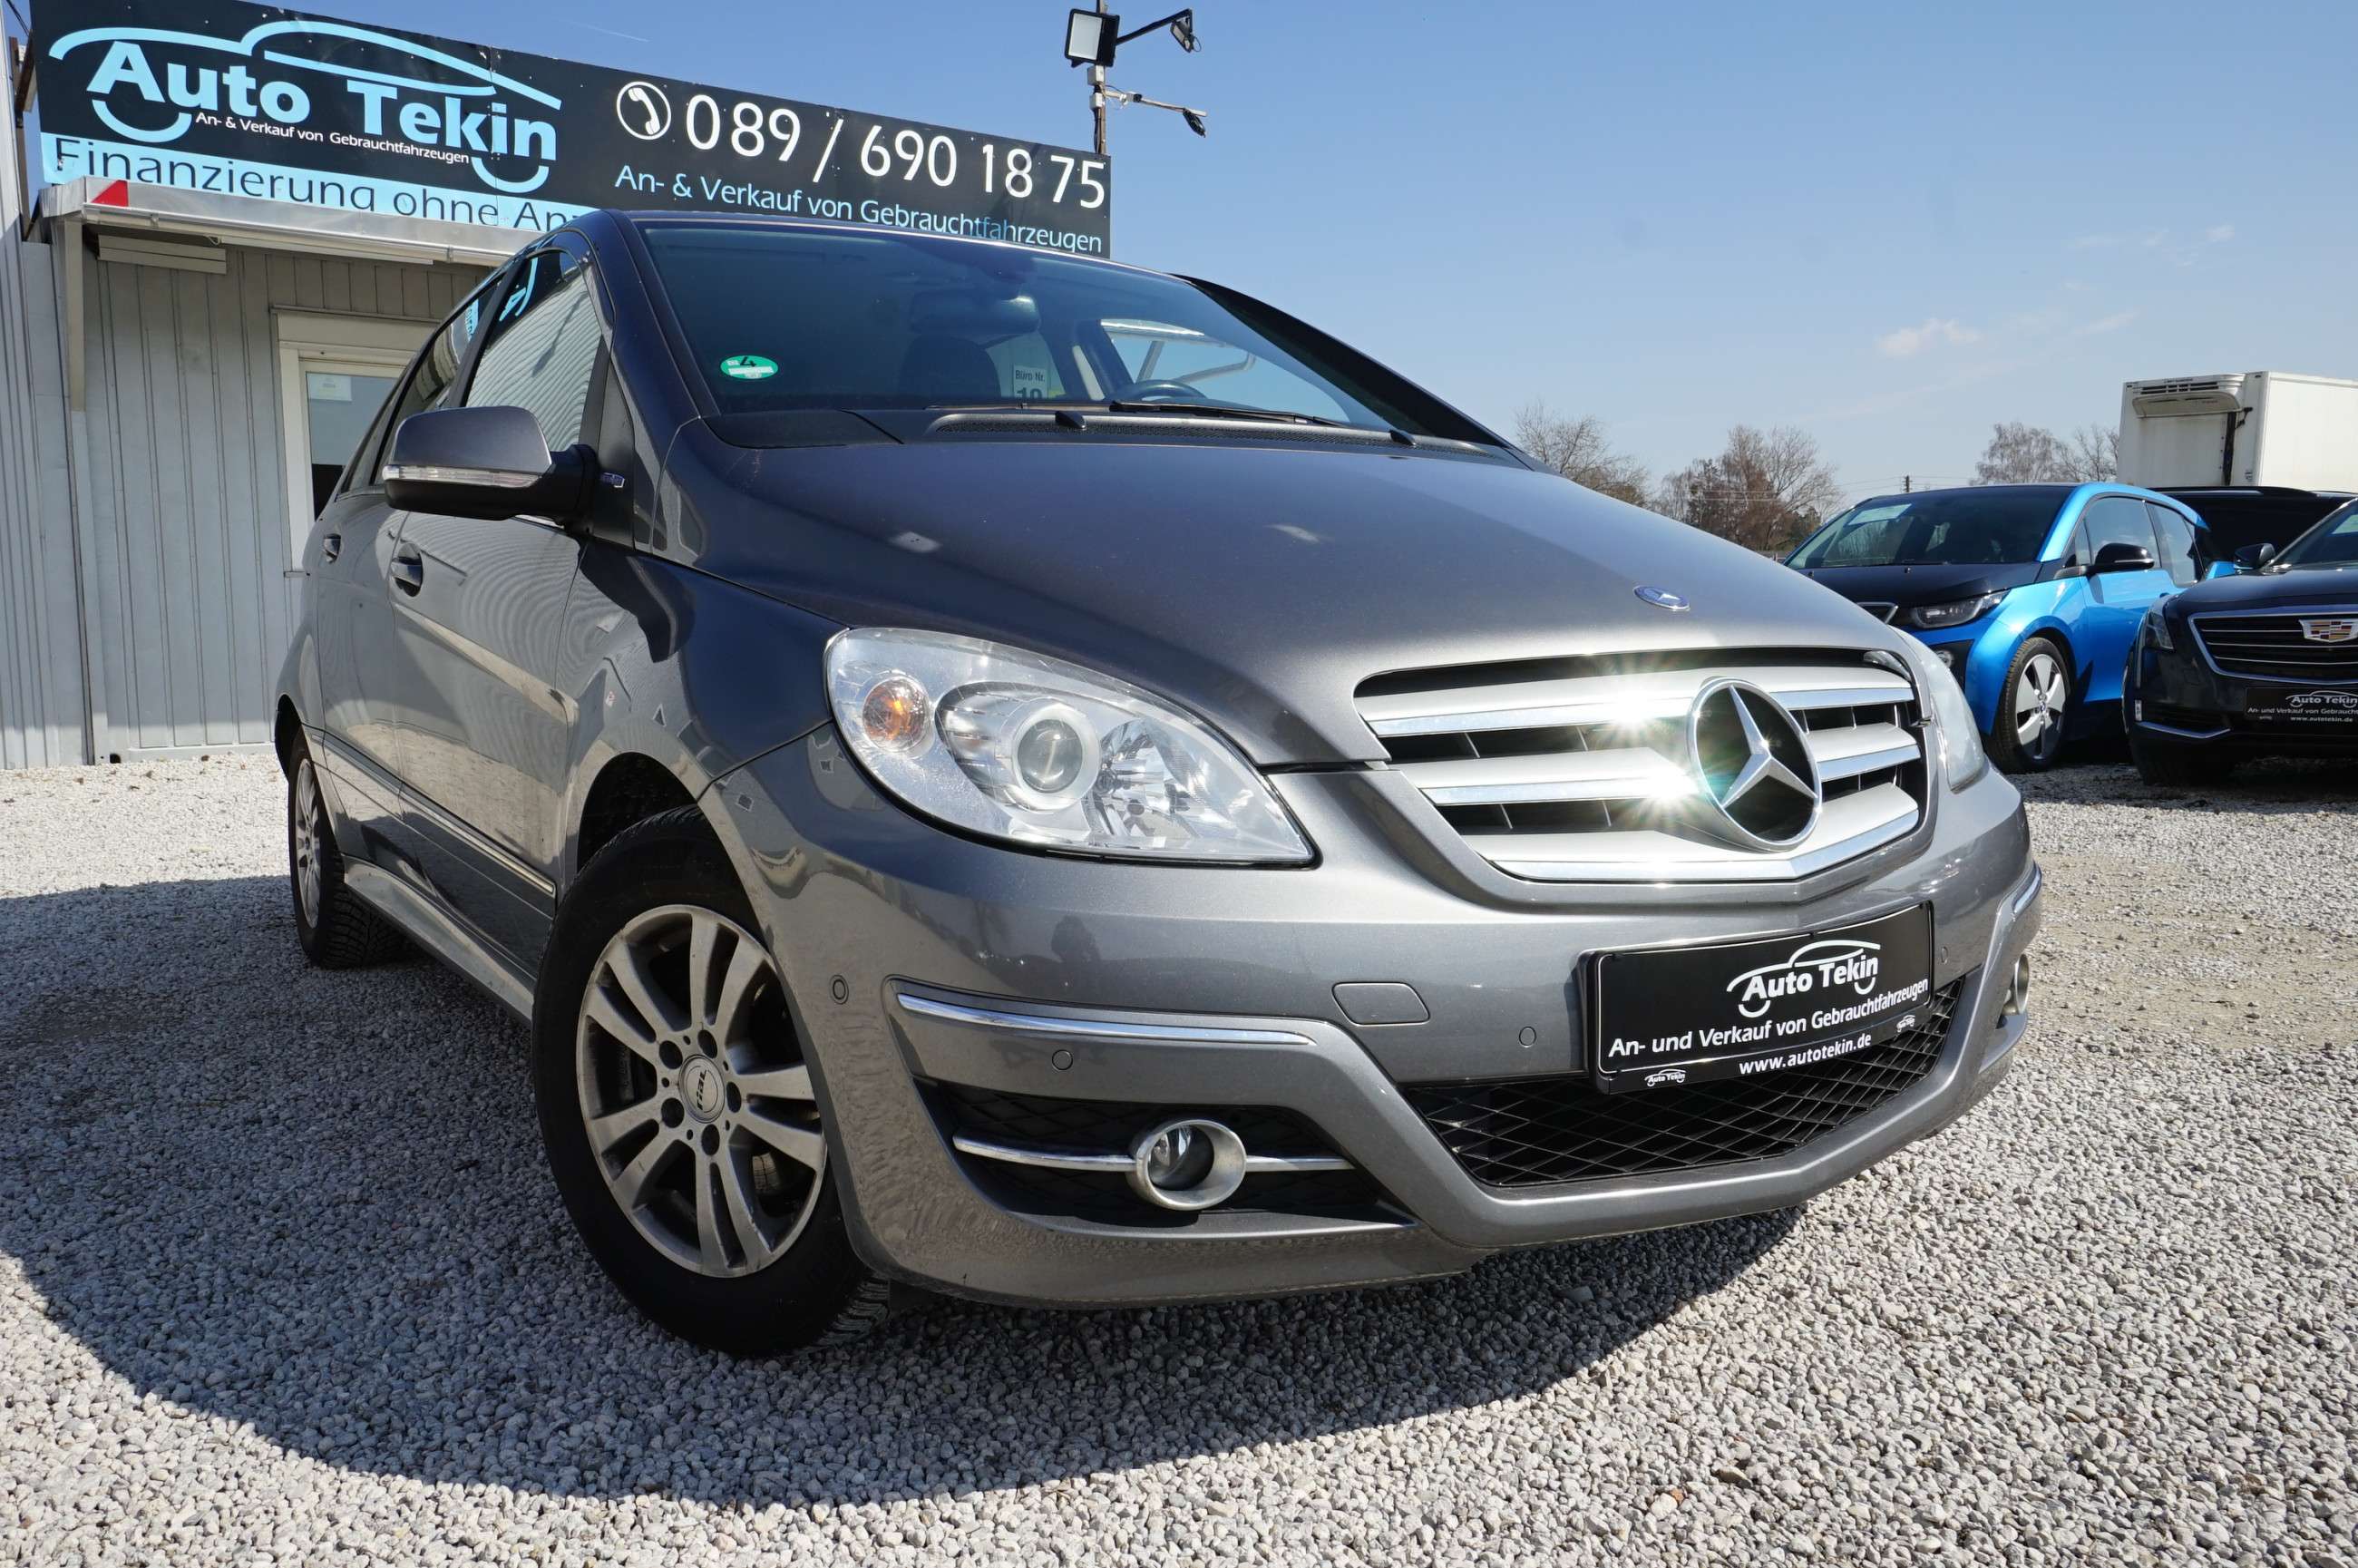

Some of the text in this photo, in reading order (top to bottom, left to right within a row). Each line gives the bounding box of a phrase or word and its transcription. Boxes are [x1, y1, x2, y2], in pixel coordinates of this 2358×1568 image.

[87, 41, 557, 161] Auto Tekin
[196, 112, 469, 164] An- & Verkauf von Gebrauchtfahrzeugen
[685, 93, 1106, 209] 089 / 690 18 75
[394, 188, 499, 226] ohne
[513, 201, 583, 231] An
[615, 165, 1102, 253] An- & Verkauf von Gebrauchtfahrzeugen
[2291, 696, 2322, 704] Auto
[1741, 955, 1879, 1002] Auto Tekin
[1608, 1038, 1646, 1057] An-
[1652, 1031, 1692, 1053] und
[1699, 1020, 1773, 1047] Verkauf
[1776, 1018, 1807, 1037] von
[1811, 978, 1929, 1029] Gebrauchtfahrzeugen
[1739, 1033, 1872, 1075] www.autotekin.de
